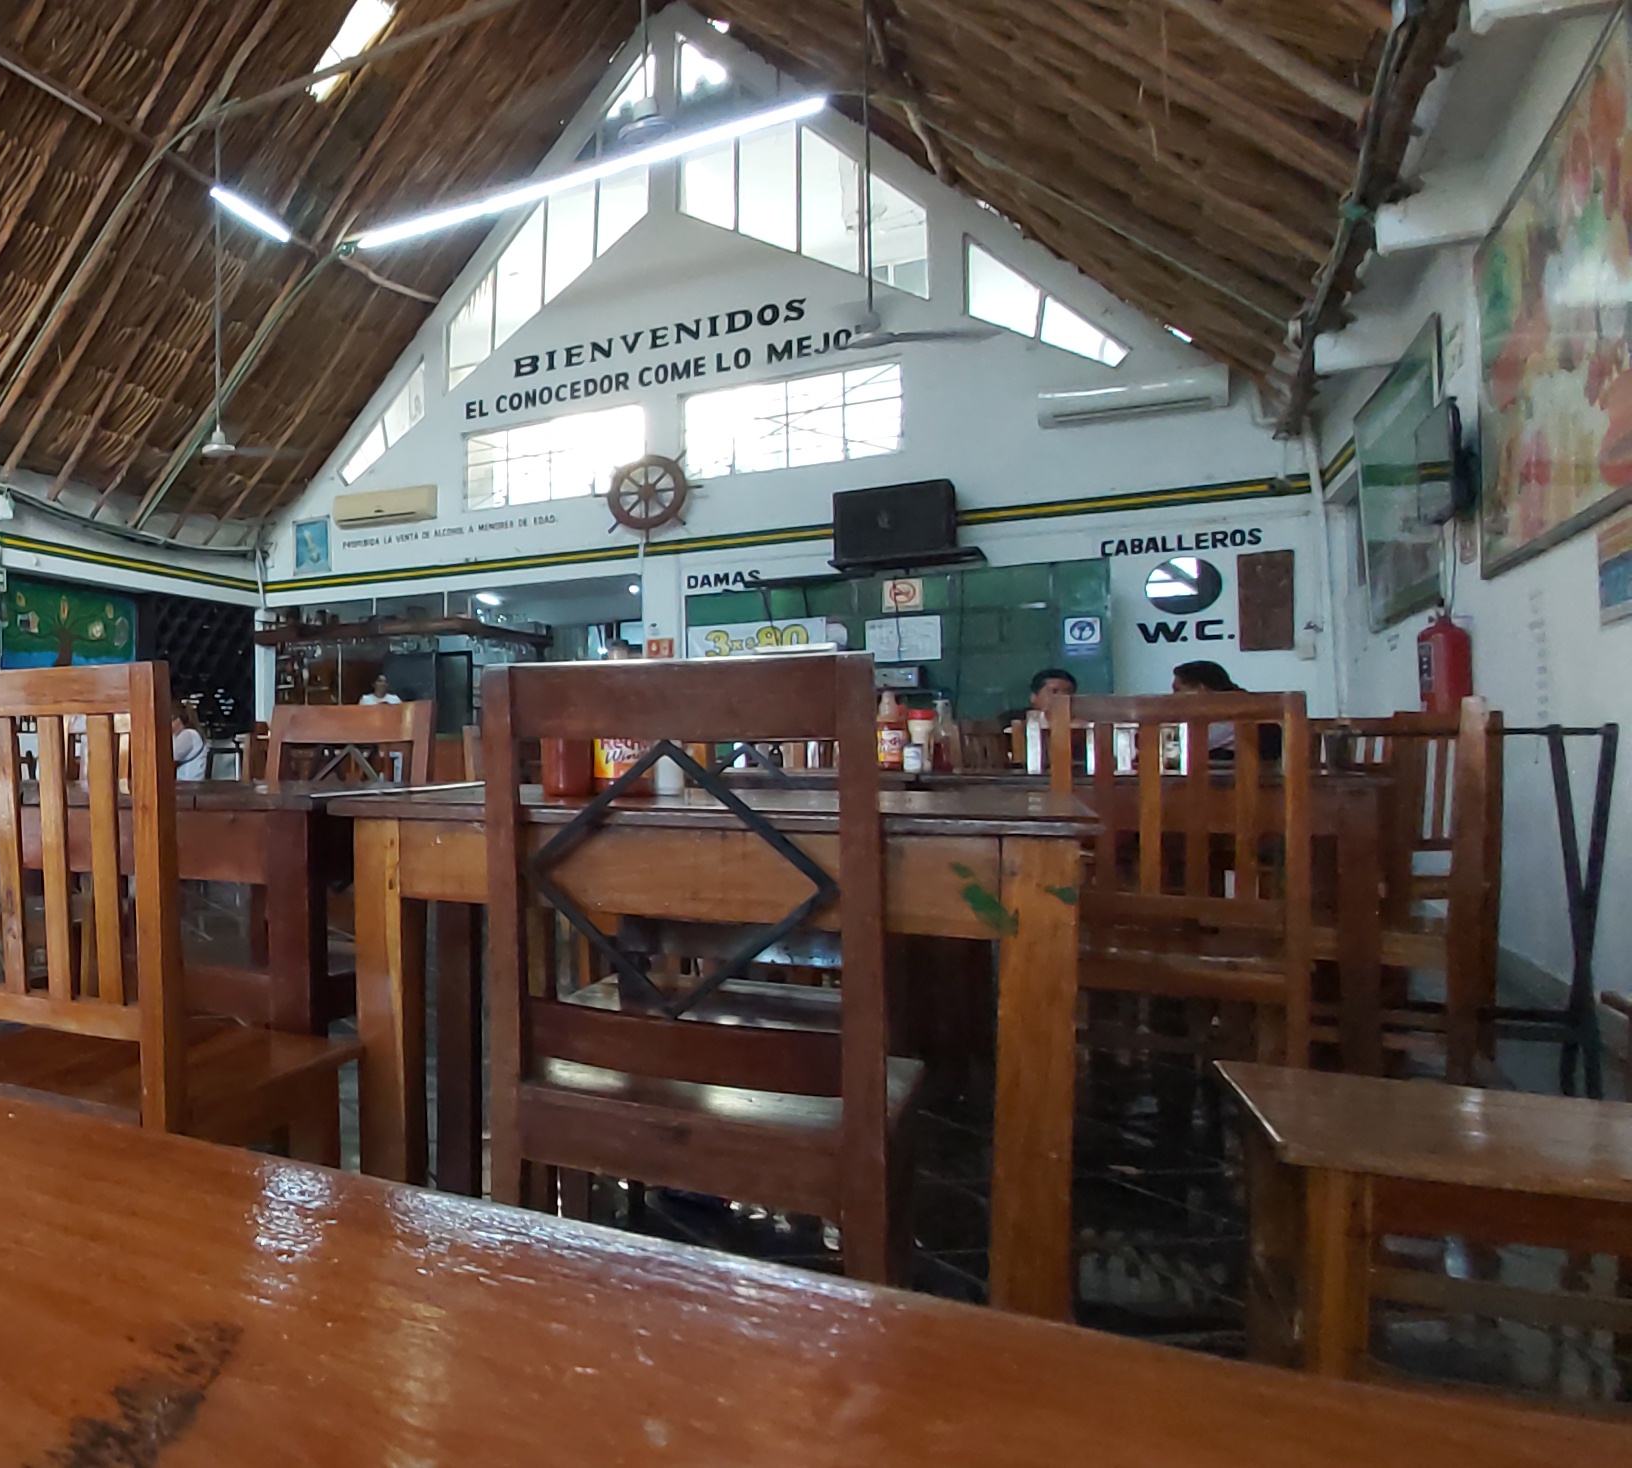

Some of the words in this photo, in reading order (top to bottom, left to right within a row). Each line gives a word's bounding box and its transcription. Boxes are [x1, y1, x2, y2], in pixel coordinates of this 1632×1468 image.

[514, 298, 806, 378] BIENVENIDOS
[465, 400, 489, 420] EL
[495, 371, 629, 414] CONOCEDOR
[638, 356, 706, 387] COME
[716, 347, 751, 374] LO
[767, 324, 861, 365] MEJO
[383, 536, 393, 546] LA
[396, 532, 419, 544] VENTA
[1100, 527, 1263, 557] CABALLEROS
[1136, 619, 1236, 644] W.C.
